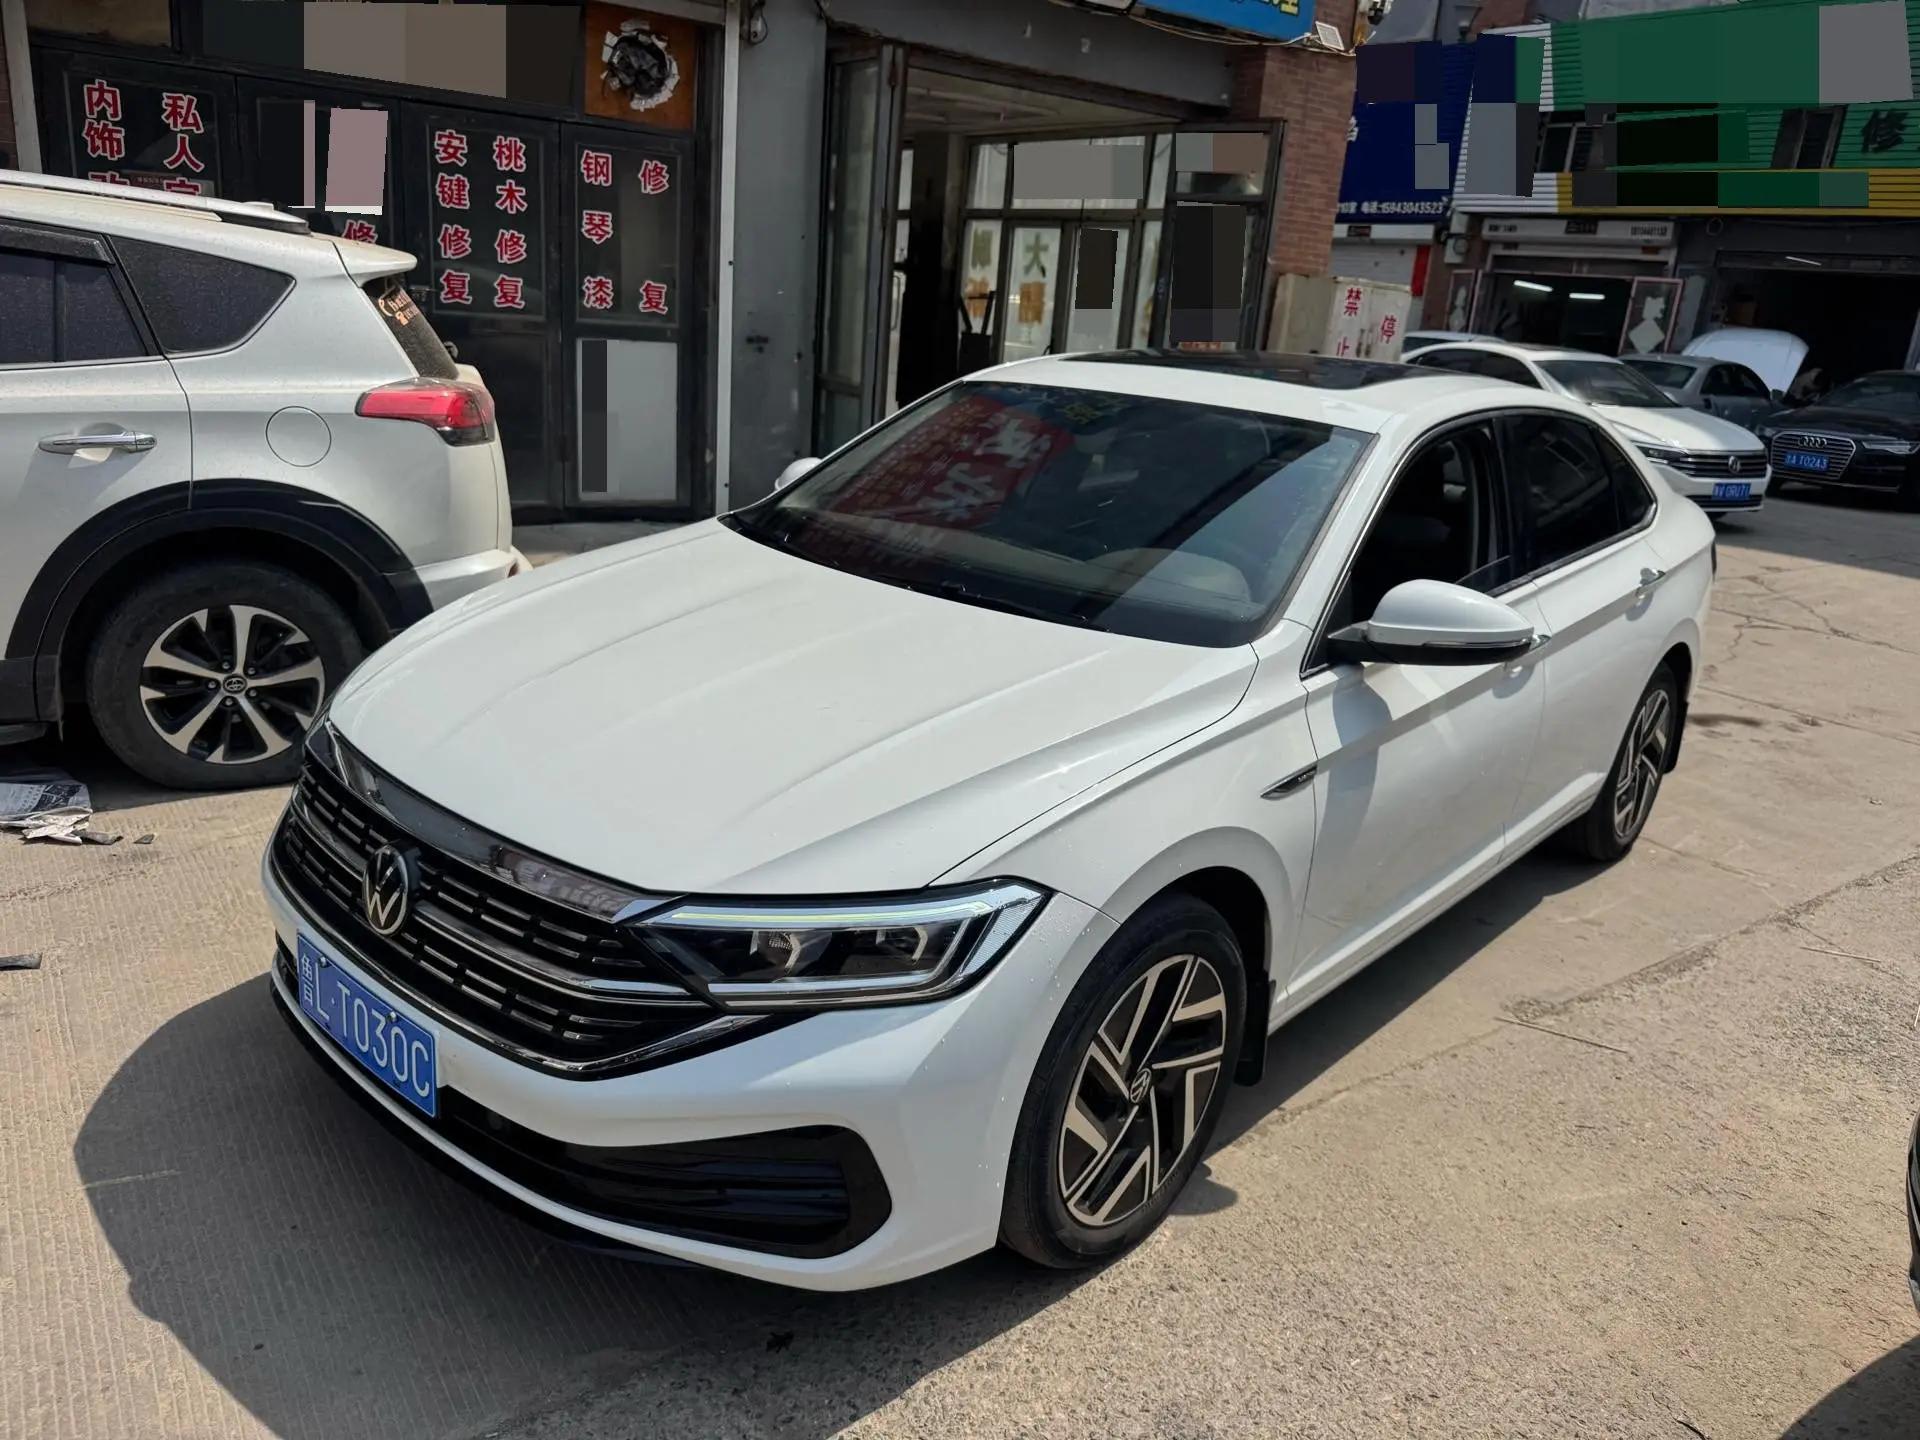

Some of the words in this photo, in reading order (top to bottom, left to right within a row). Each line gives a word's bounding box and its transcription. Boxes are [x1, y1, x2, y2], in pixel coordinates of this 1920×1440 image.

[435, 129, 472, 304] 安键修复
[493, 136, 527, 308] 桃木修复
[581, 150, 614, 310] 钢琴漆
[639, 159, 669, 314] 修复
